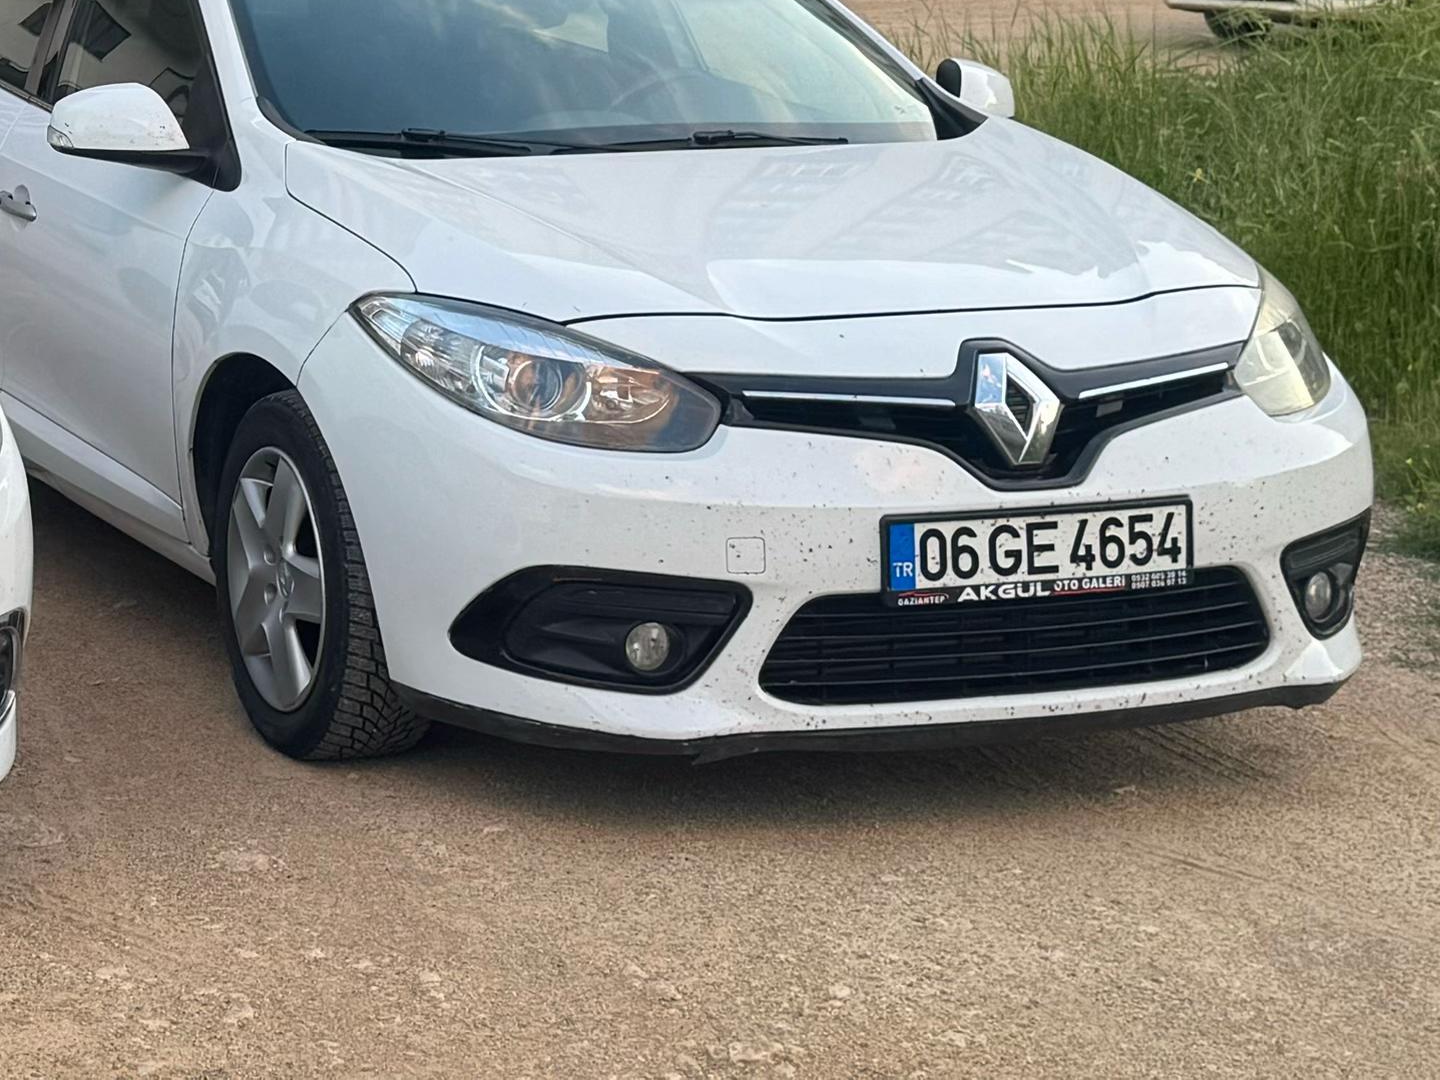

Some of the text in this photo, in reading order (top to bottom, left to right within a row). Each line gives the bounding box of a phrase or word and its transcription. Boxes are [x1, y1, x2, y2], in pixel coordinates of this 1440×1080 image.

[919, 511, 1182, 582] 06 GE 4654
[892, 561, 914, 578] TR
[957, 581, 1052, 603] AKGÜL
[1053, 579, 1079, 592] OTO
